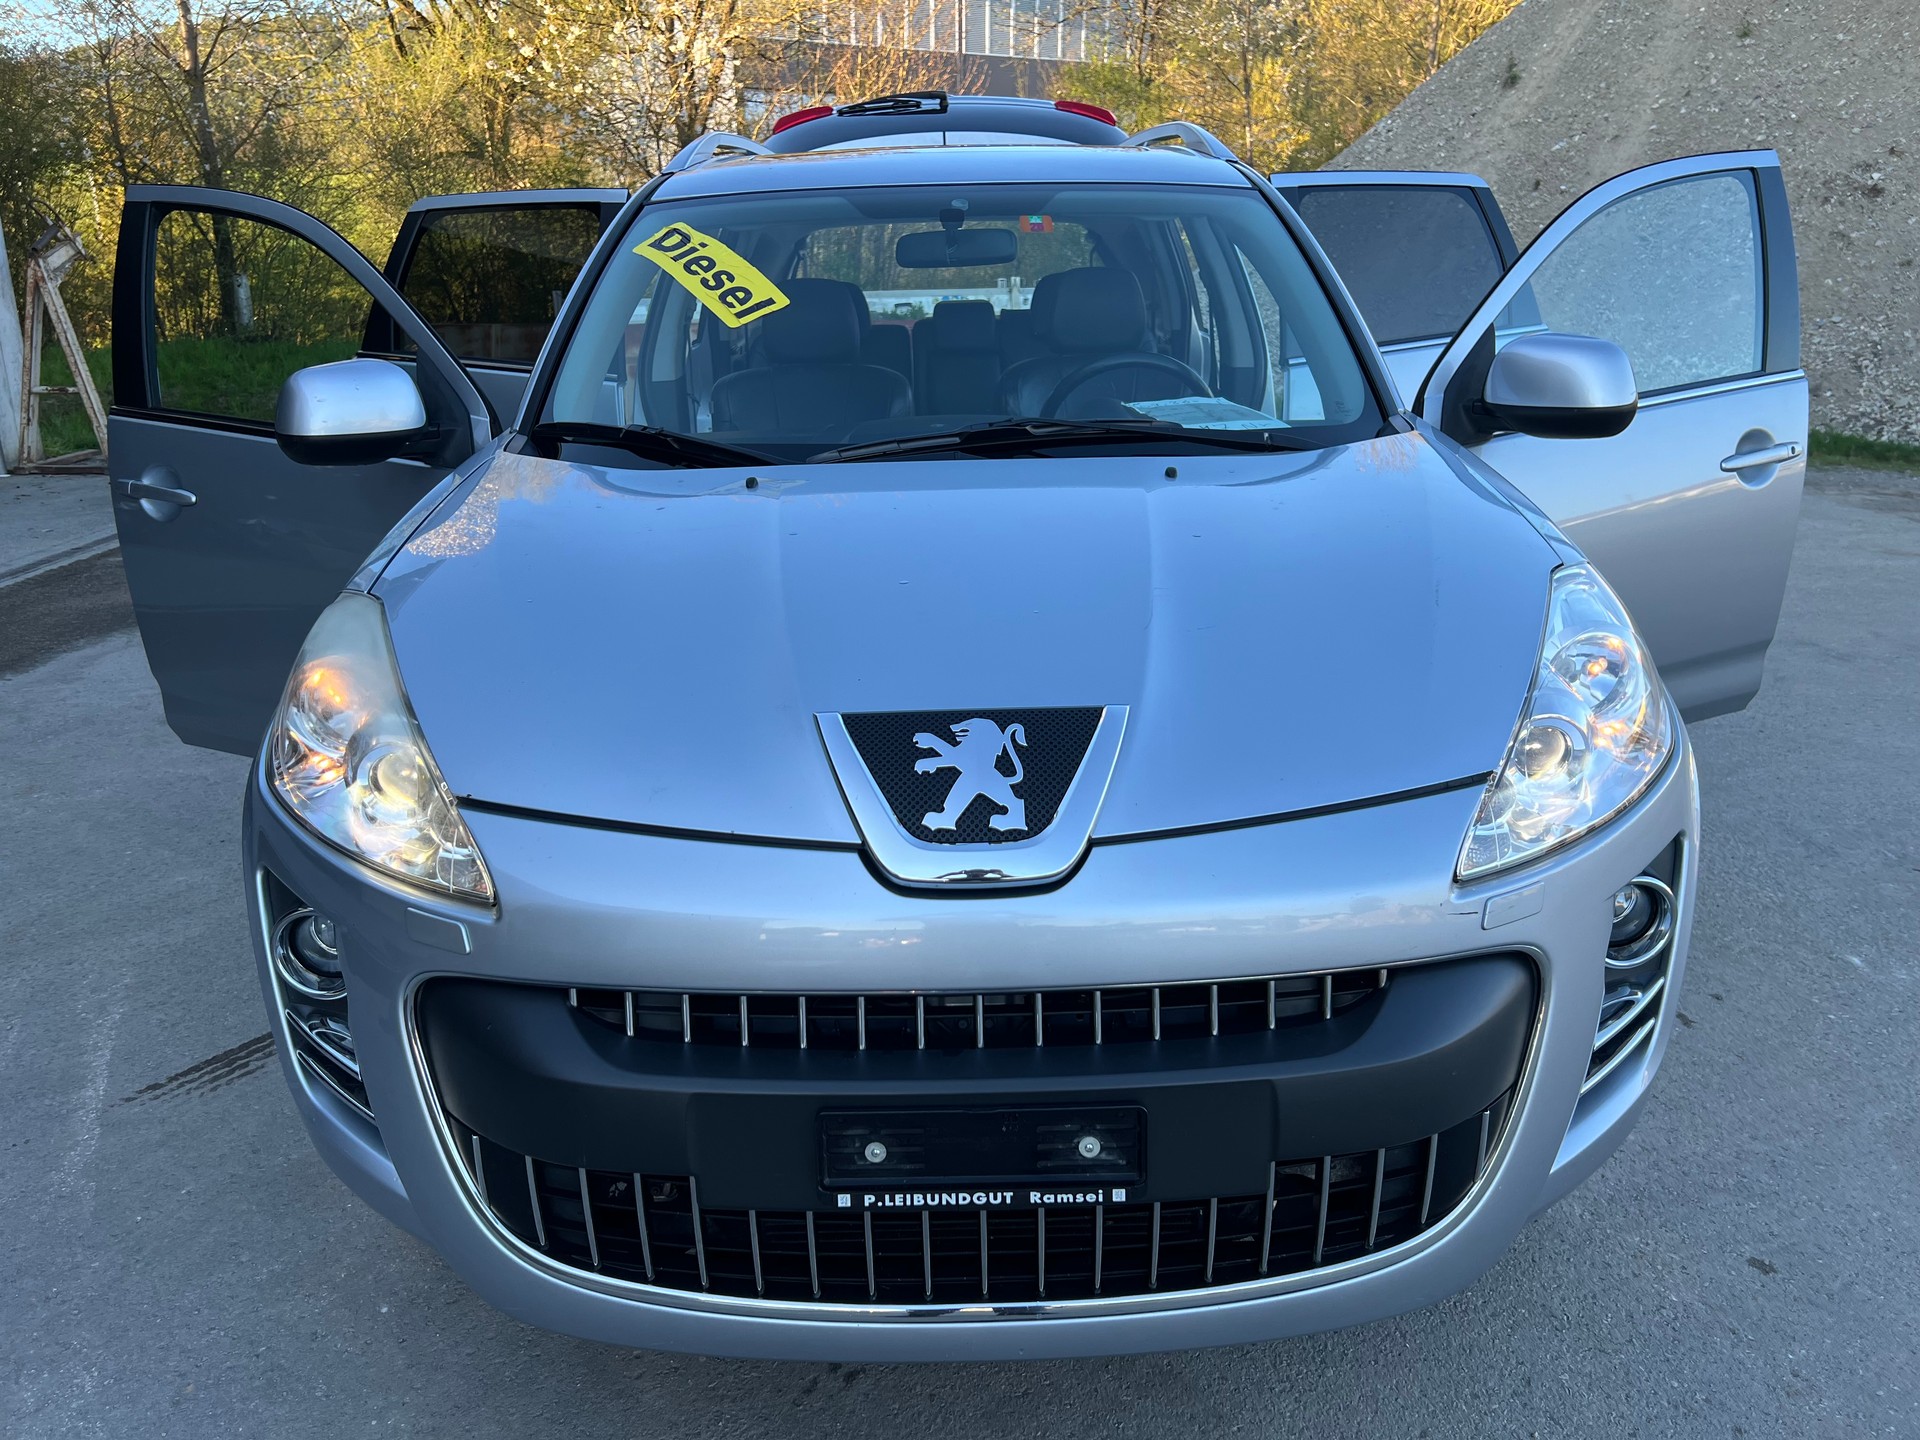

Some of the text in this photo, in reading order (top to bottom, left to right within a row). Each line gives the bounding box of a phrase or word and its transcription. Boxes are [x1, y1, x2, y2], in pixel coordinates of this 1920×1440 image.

[648, 228, 777, 319] Diesel
[864, 1189, 1104, 1207] P.LEIBUNDGUT Ramsei
